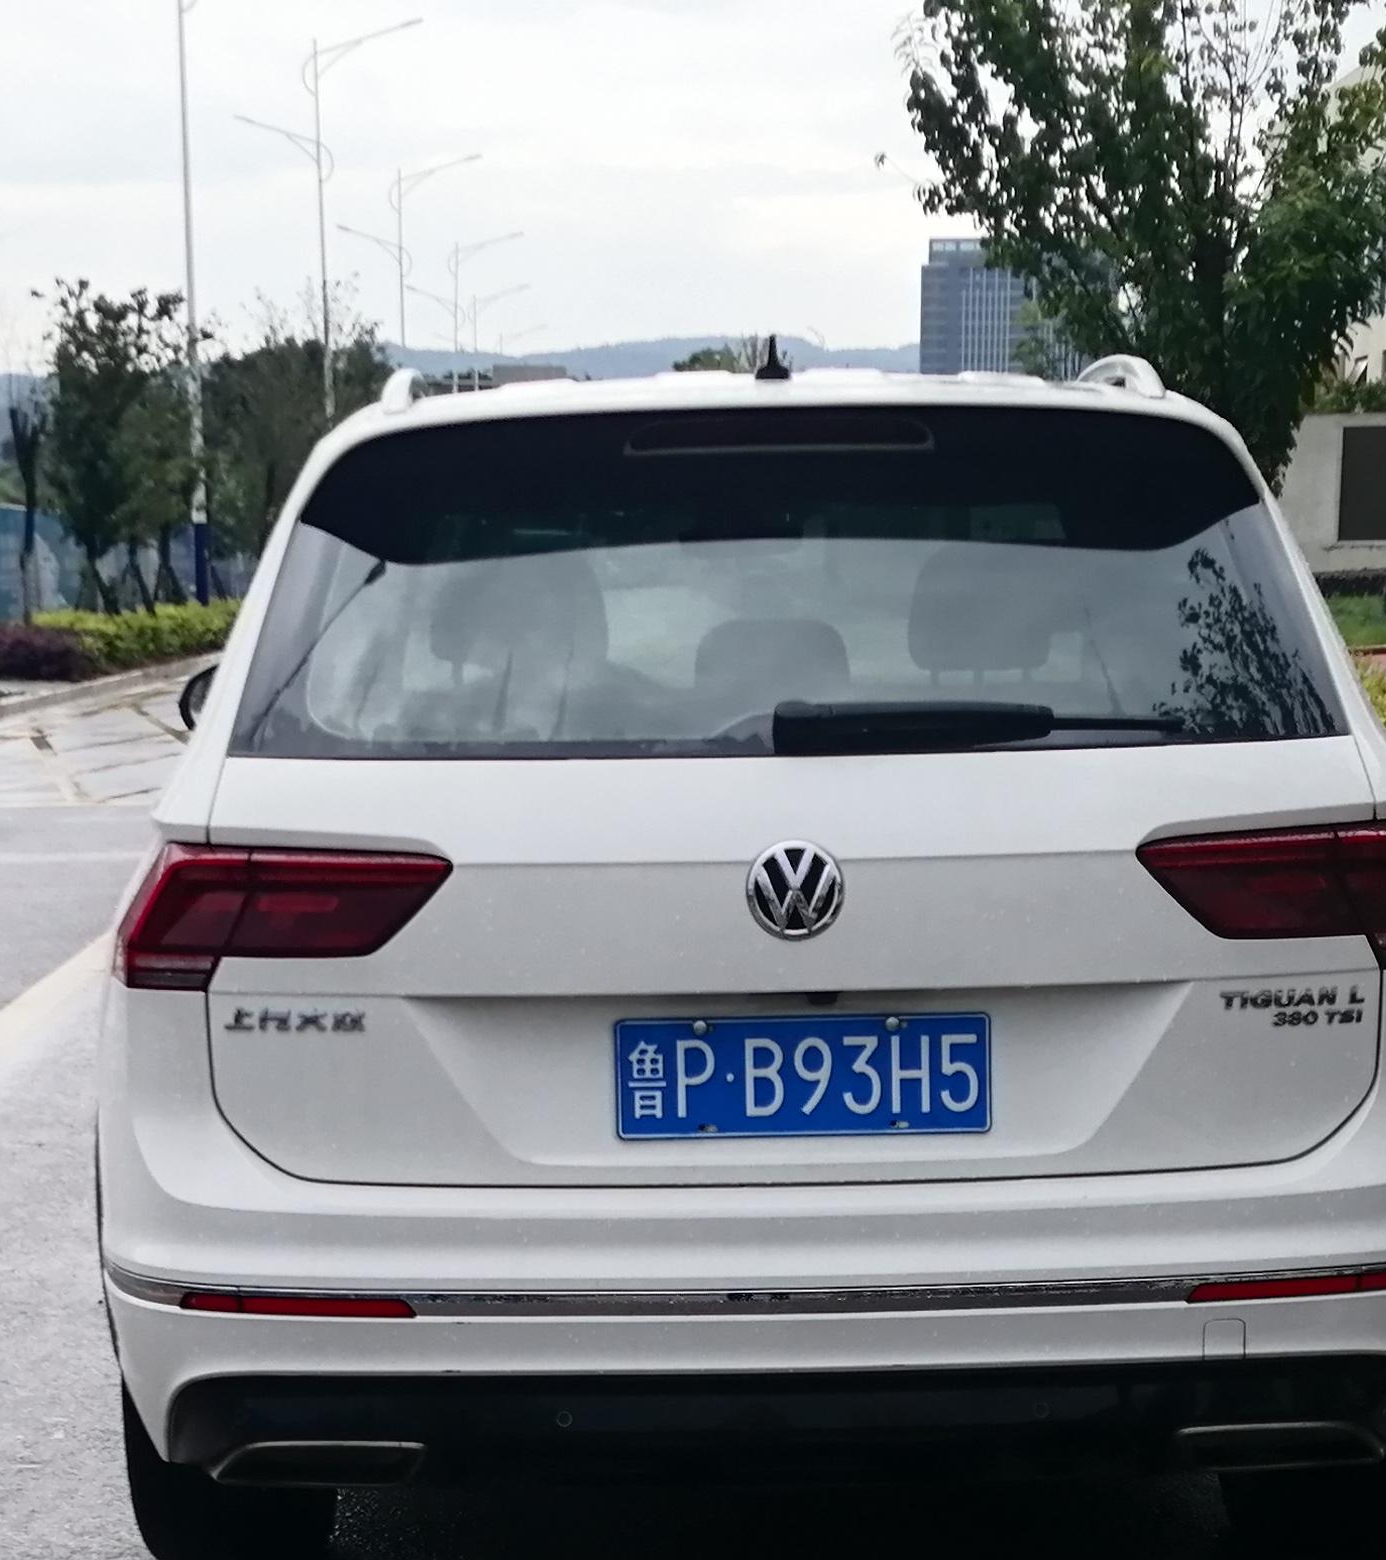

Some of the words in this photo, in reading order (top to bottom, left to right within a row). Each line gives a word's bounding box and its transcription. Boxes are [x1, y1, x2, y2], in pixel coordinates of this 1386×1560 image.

[1220, 986, 1338, 1010] TIGUAN
[1348, 984, 1365, 1005] L
[1273, 1010, 1319, 1027] 380
[1325, 1008, 1363, 1025] TSI
